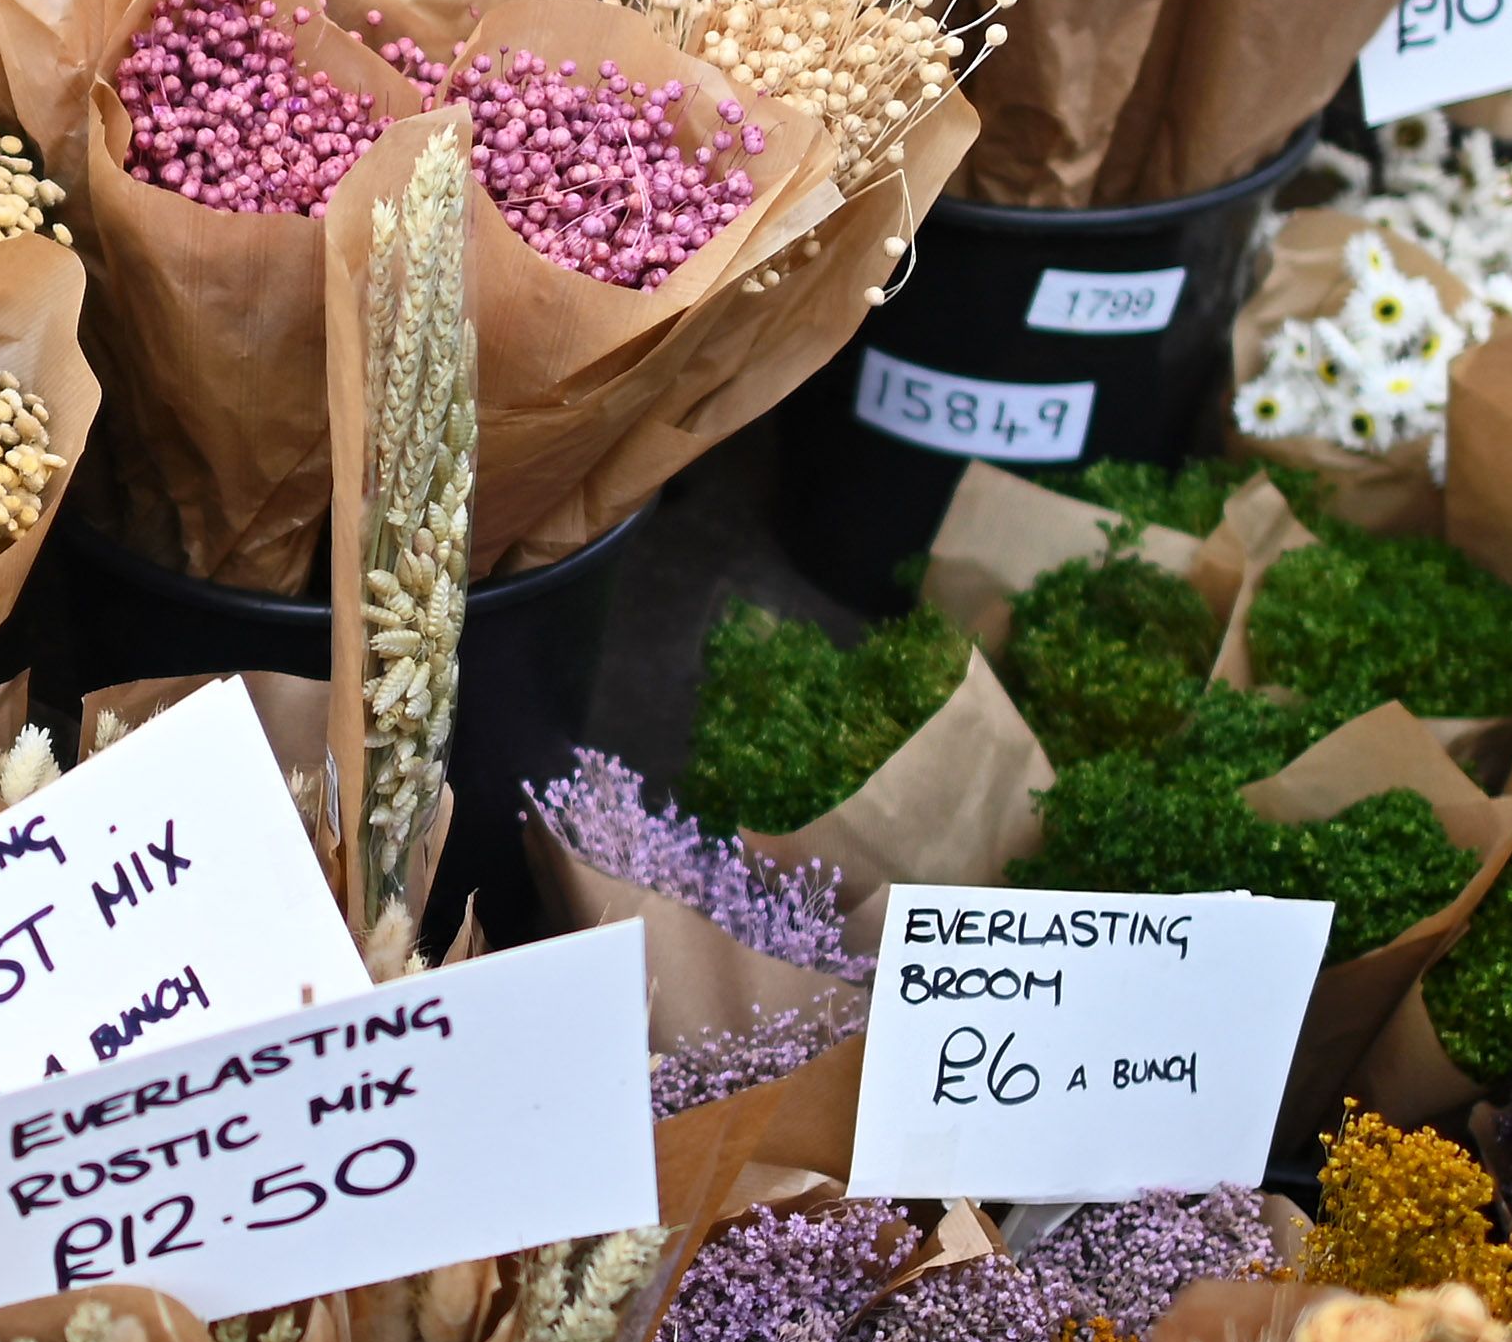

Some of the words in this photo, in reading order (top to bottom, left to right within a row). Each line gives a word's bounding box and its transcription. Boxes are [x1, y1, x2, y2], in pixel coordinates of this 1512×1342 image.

[1068, 286, 1156, 320] 1799
[876, 369, 1070, 446] 15849
[90, 819, 192, 928] MIX
[904, 908, 1193, 960] EVERLASTING
[89, 965, 211, 1060] BUNCH
[899, 963, 1063, 1007] BROOM
[10, 997, 453, 1161] EVERLASTING
[932, 1025, 1041, 1105] £6
[1066, 1064, 1088, 1092] A
[1112, 1051, 1198, 1095] BUNCH
[8, 1115, 261, 1216] RUSTIC
[54, 1138, 417, 1292] £12.50
